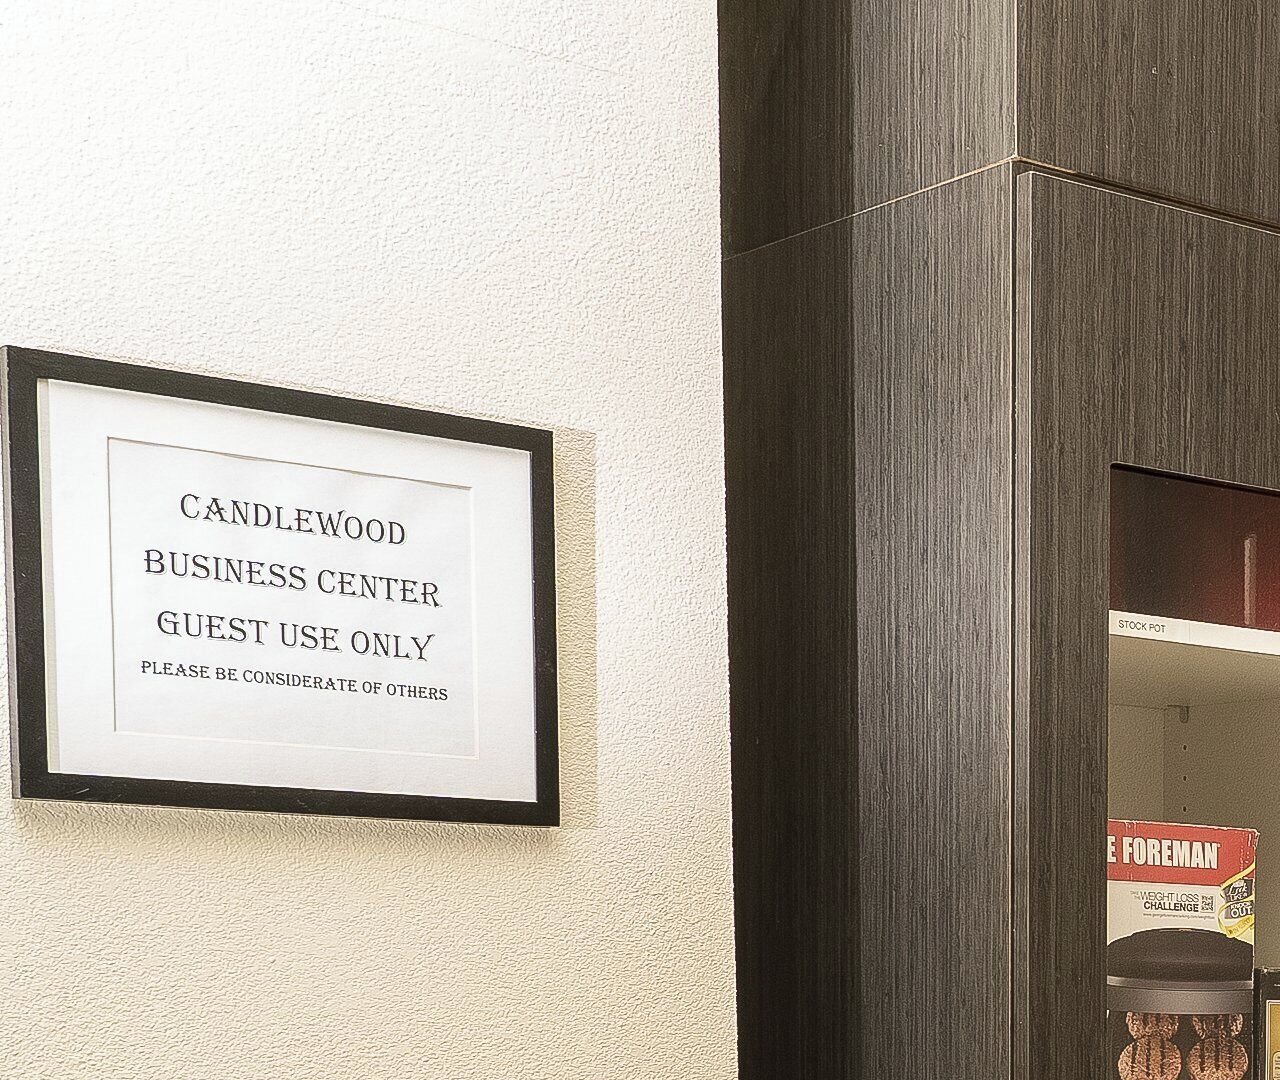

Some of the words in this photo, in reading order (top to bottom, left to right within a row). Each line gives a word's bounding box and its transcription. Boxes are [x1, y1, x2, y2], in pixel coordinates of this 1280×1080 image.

[180, 493, 406, 545] CANDLEWOOD
[143, 548, 307, 592] BUSINESS
[317, 569, 442, 608] CENTER
[157, 610, 269, 645] GUEST
[280, 622, 340, 653] USE
[350, 631, 436, 662] ONLY
[1118, 618, 1147, 632] STOCK
[1148, 622, 1166, 634] POT
[141, 660, 211, 680] PLEASE
[215, 666, 239, 682] BE
[242, 667, 358, 694] CONSIDERATE
[362, 680, 382, 695] OF
[386, 681, 449, 702] OTHERS
[1122, 836, 1218, 870] FOREMAN
[1140, 891, 1176, 902] WEIGHT
[1176, 893, 1200, 903] LOSS
[1144, 902, 1200, 912] CHALLENGE
